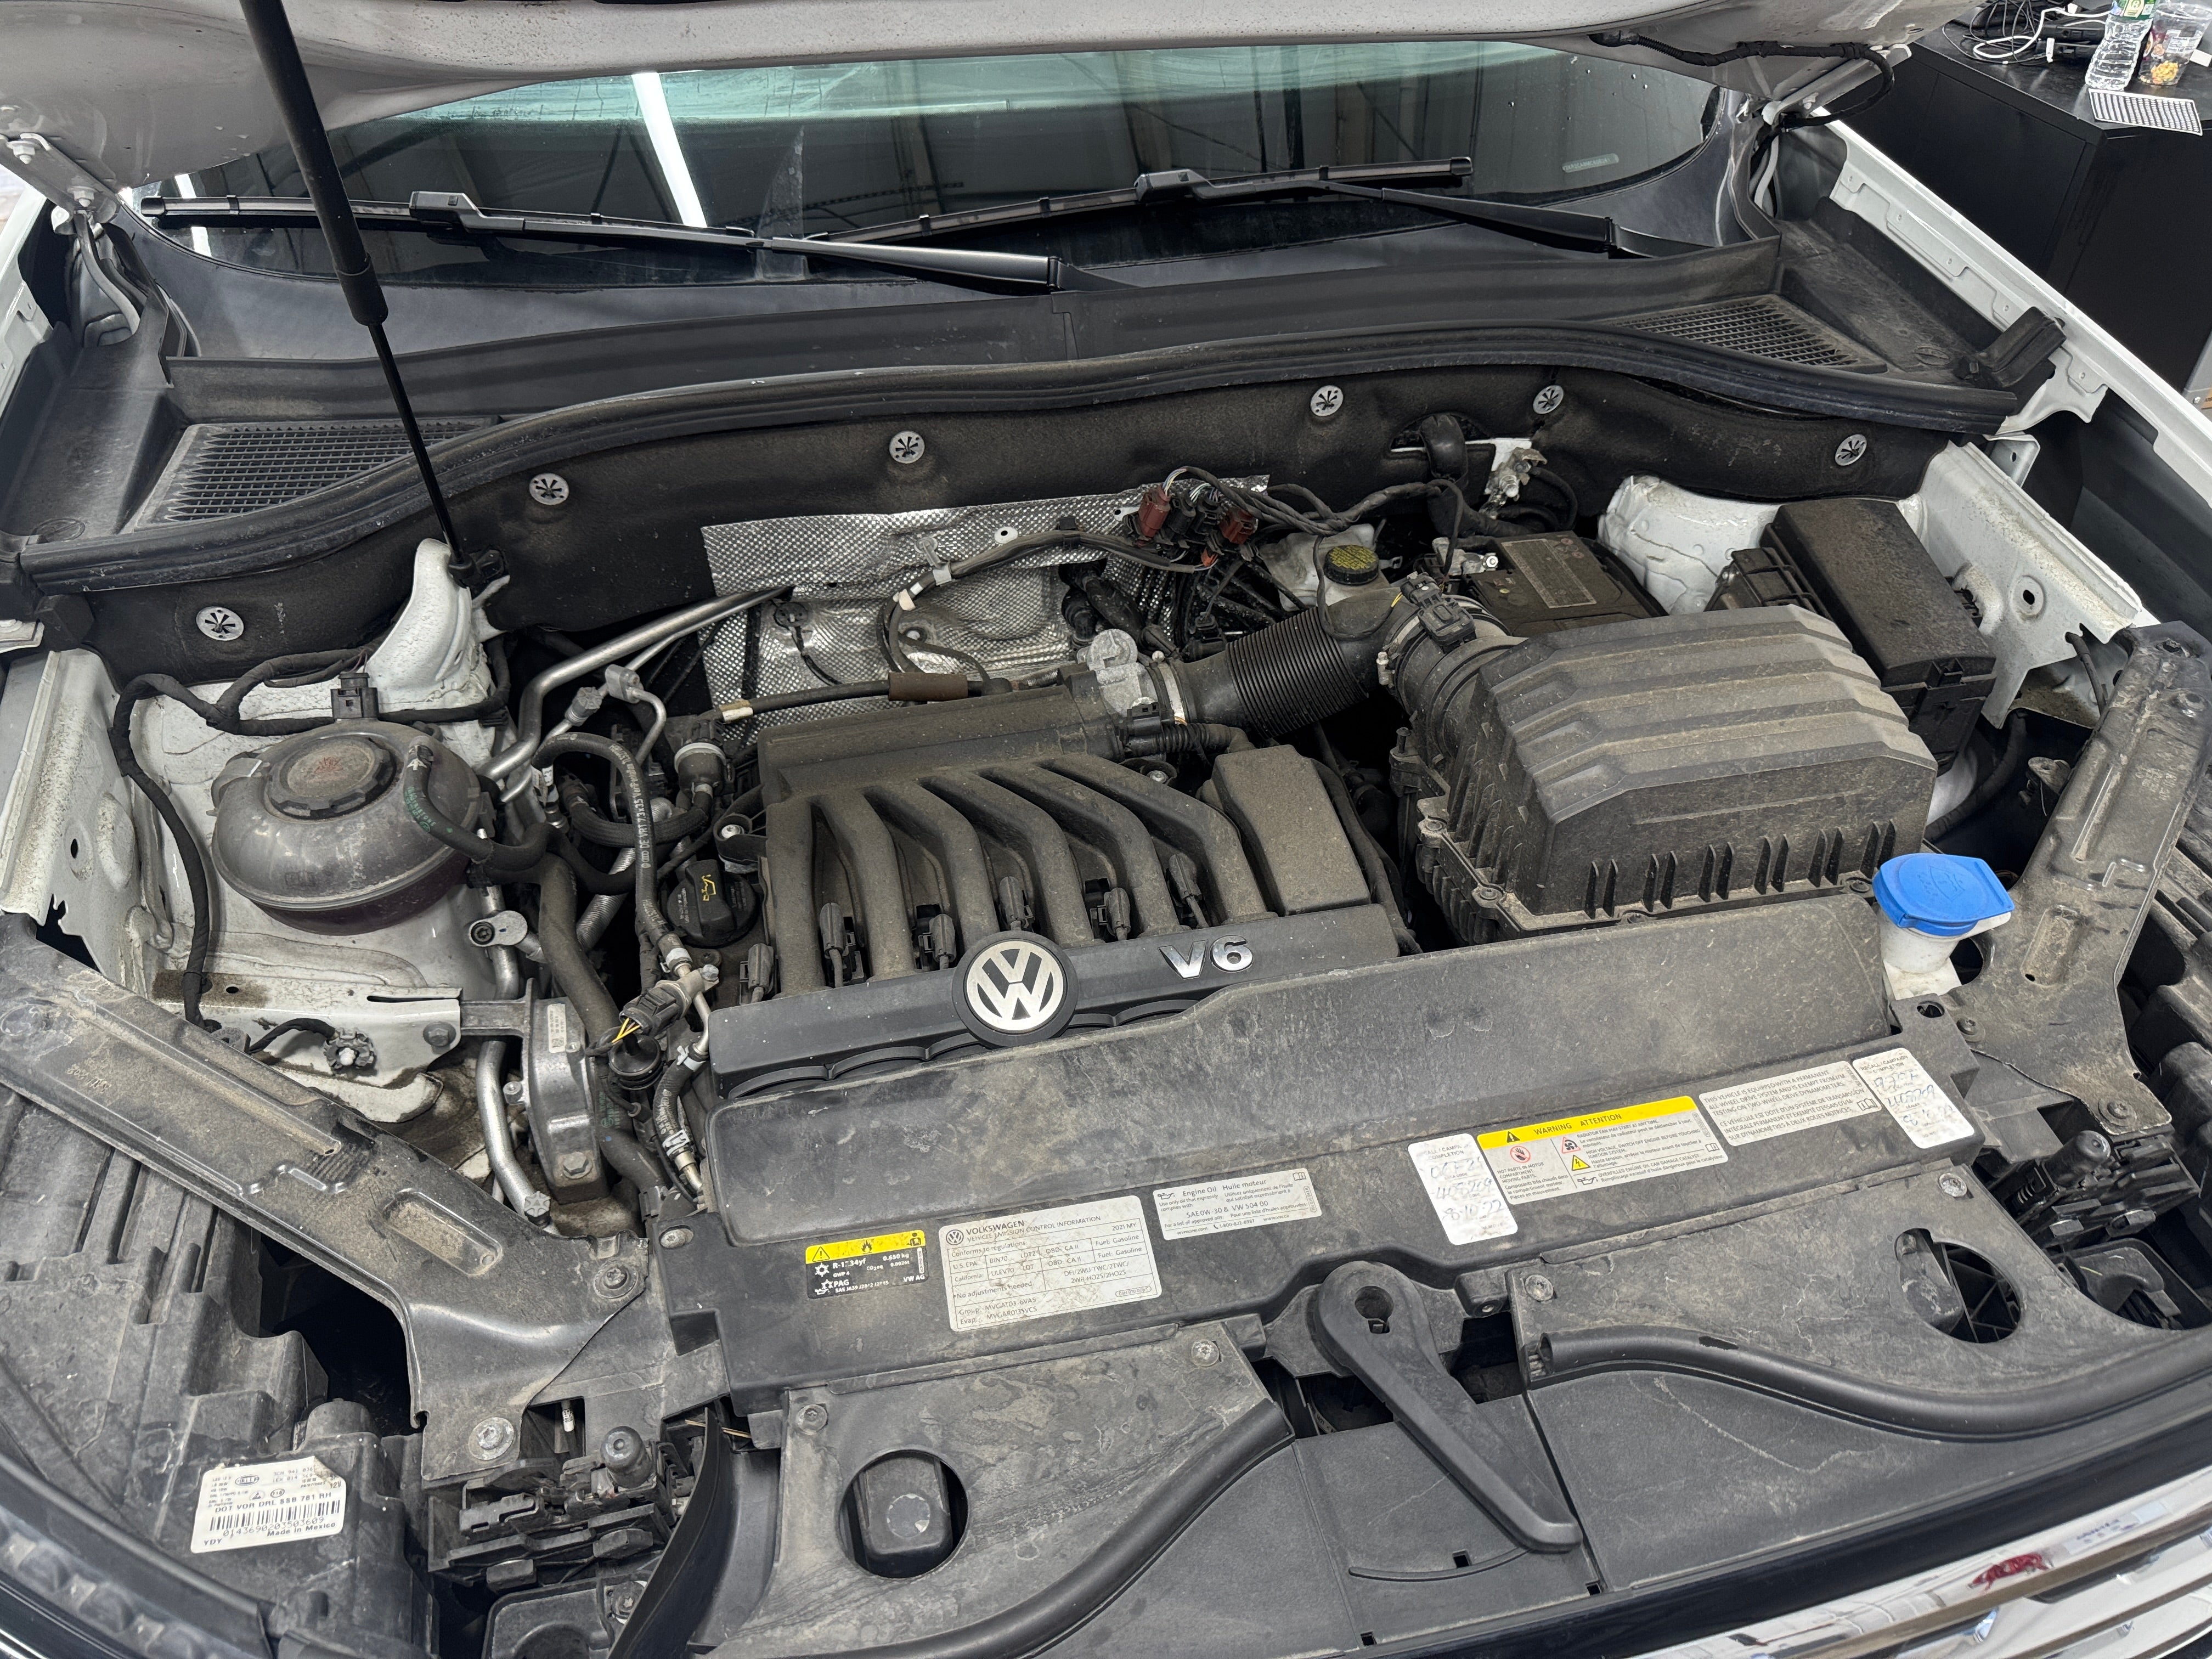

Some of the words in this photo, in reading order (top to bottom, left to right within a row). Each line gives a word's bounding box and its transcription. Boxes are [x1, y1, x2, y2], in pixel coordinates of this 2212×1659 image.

[638, 824, 648, 838] VRT
[1158, 934, 1254, 979] V6
[1717, 1091, 1741, 1100] VEHICLE
[1746, 1083, 1775, 1093] EQUIPPED
[1796, 1070, 1830, 1081] PERMANENT
[1756, 1090, 1778, 1098] SYSTEM
[1797, 1080, 1820, 1088] EXEMPT
[1712, 1107, 1737, 1116] TESTING
[1781, 1092, 1799, 1100] DRIVE
[1726, 1114, 1754, 1124] VÉHICULE
[1825, 1088, 1865, 1101] TRANSMISSION
[1533, 1122, 1572, 1135] WARNING
[1578, 1113, 1622, 1126] ATTENTION
[1723, 1122, 1754, 1133] INTÉGRALE
[1752, 1114, 1786, 1126] PERMANENT
[1805, 1113, 1826, 1121] ROUES
[1182, 1188, 1206, 1198] Engine
[1241, 1178, 1267, 1187] moteur
[1199, 1207, 1222, 1216] 0W-30
[966, 1220, 1025, 1235] VOLKSWAGEN
[967, 1233, 992, 1242] VEHICLE
[994, 1227, 1025, 1238] EMISSION
[1025, 1222, 1056, 1233] CONTROL
[1057, 1215, 1101, 1228] INFORMATION
[883, 1253, 900, 1261] 0.650
[951, 1247, 981, 1257] Conforms
[989, 1255, 1008, 1263] BIN70
[1112, 1234, 1139, 1243] Gasoline
[991, 1267, 1014, 1276] ULEV70
[1115, 1246, 1142, 1255] Gasoline
[833, 1278, 849, 1287] PAG
[967, 1285, 1007, 1297] adjustments
[1008, 1280, 1032, 1291] needed
[267, 1528, 290, 1537] Made
[305, 1522, 335, 1531] Mexico
